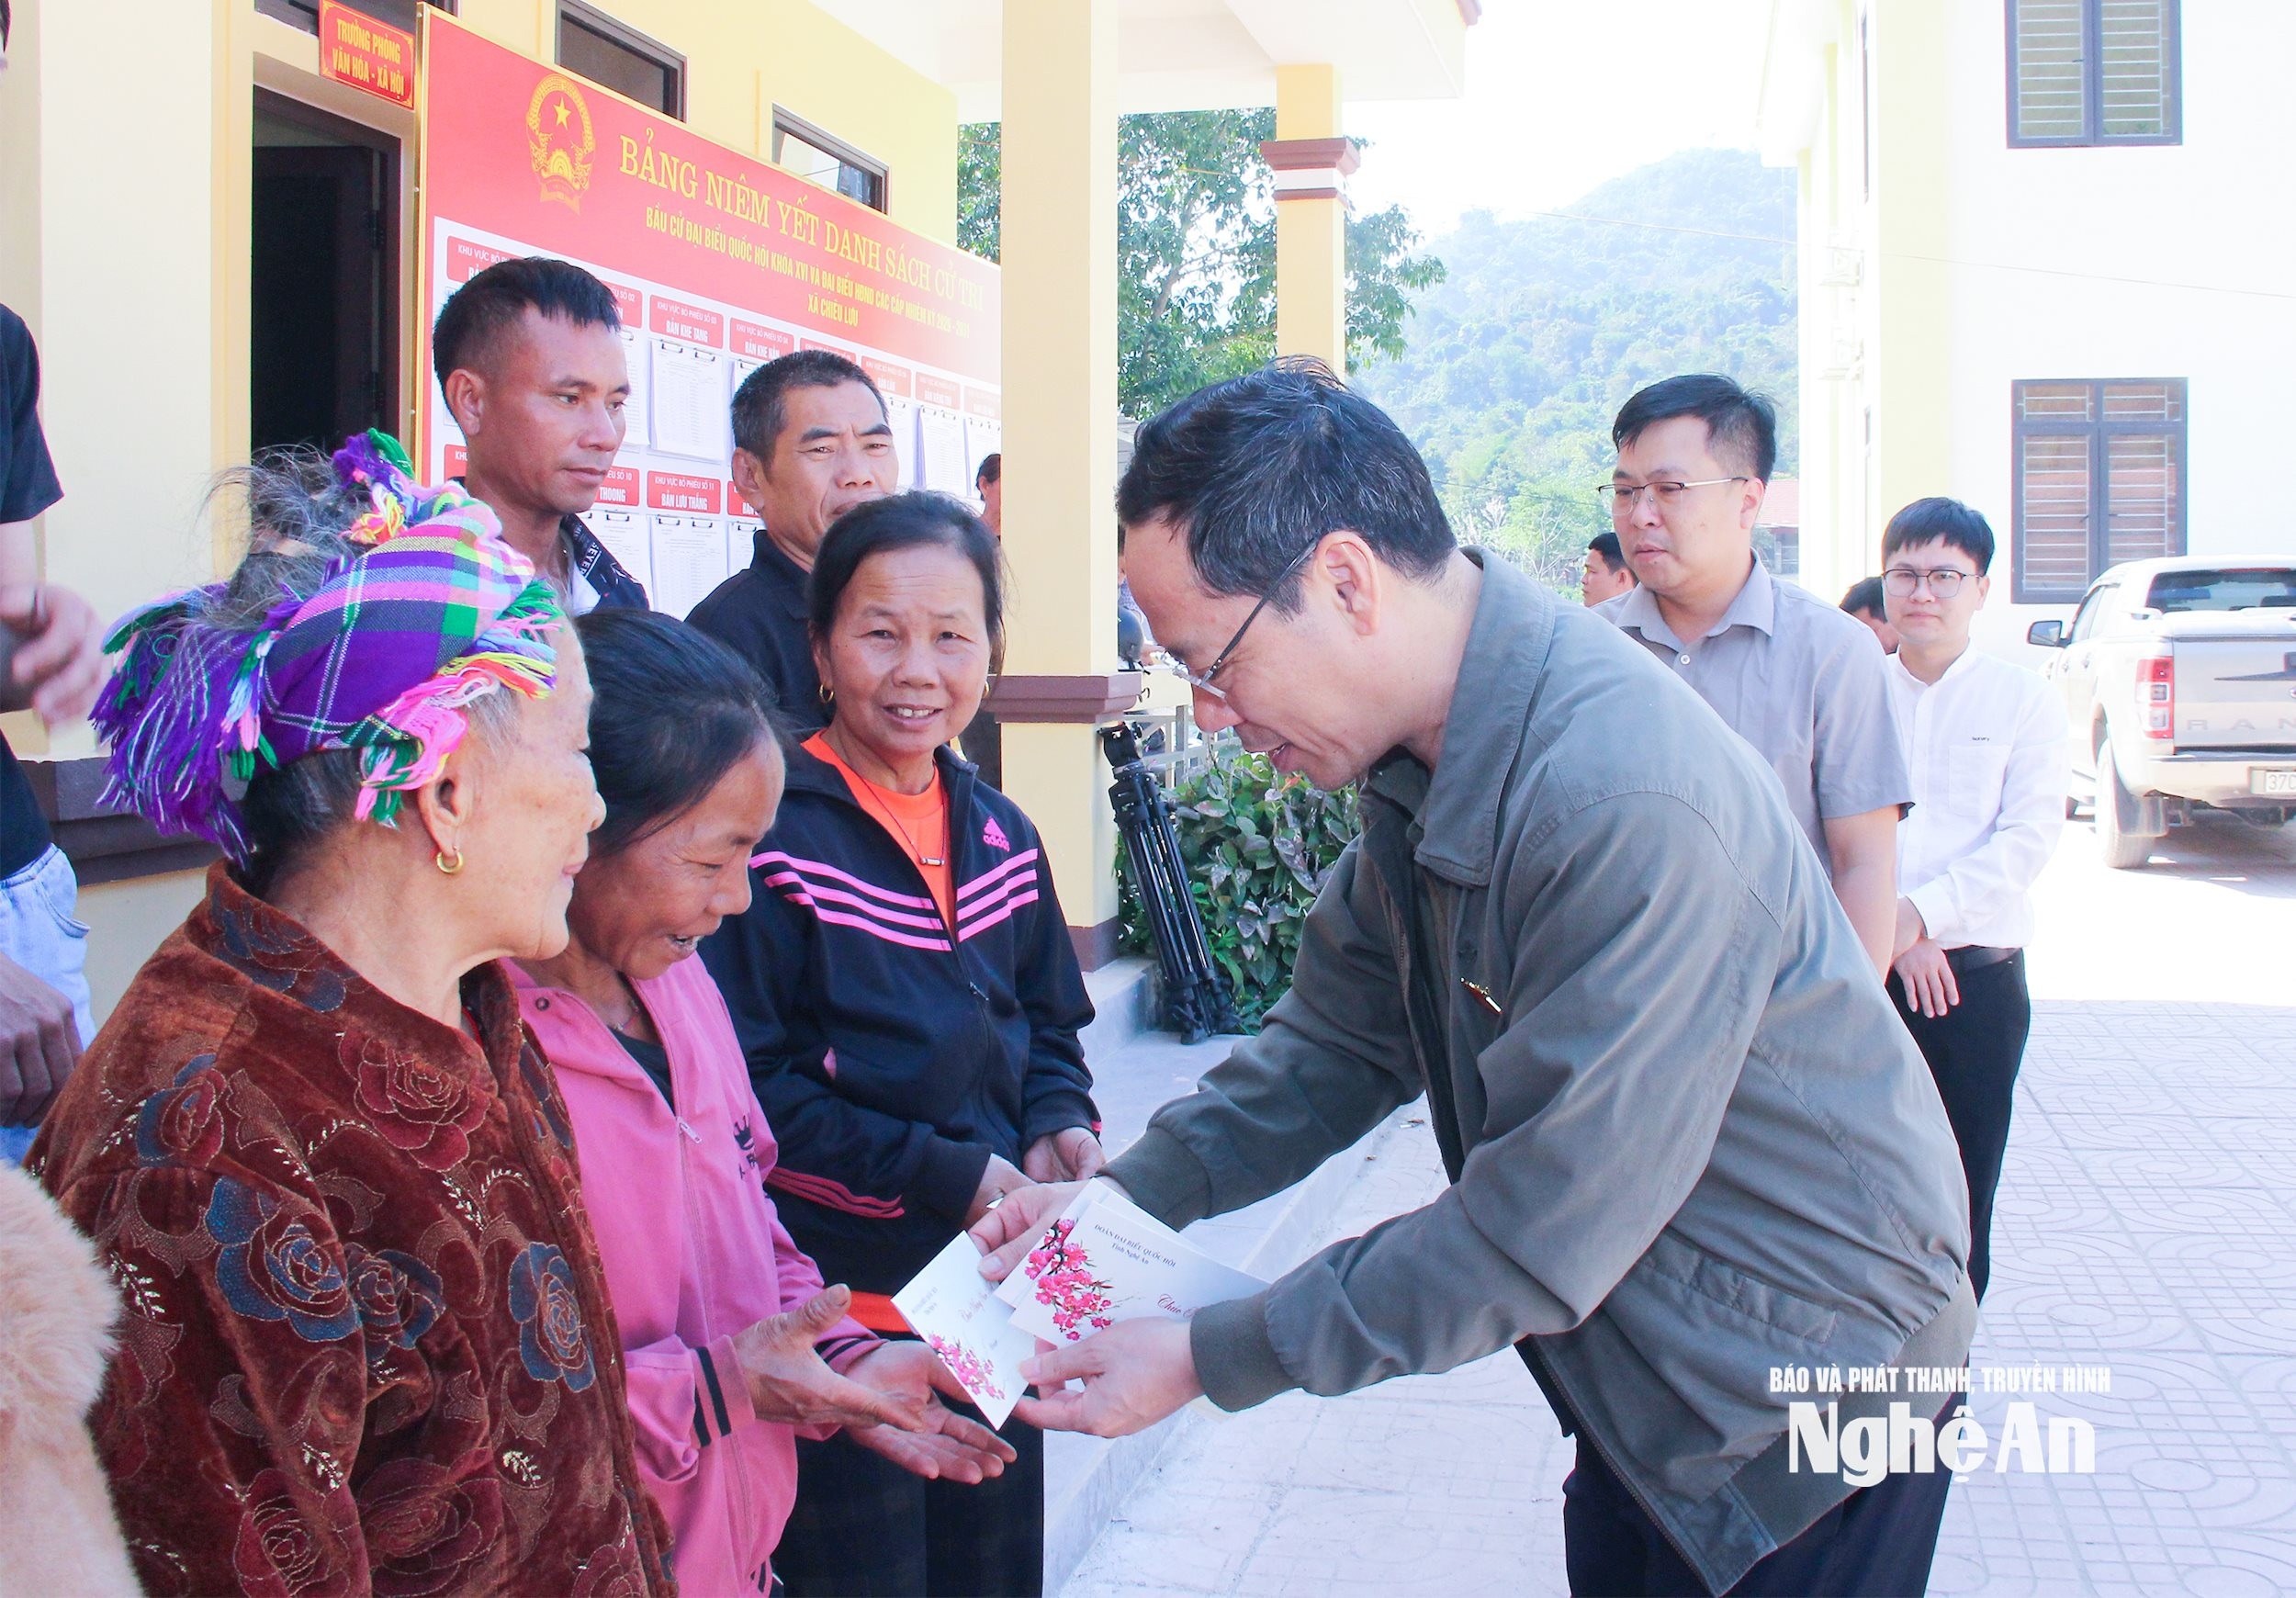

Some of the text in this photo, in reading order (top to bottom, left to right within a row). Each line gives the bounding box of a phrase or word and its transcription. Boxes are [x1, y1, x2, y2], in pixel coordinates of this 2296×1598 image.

[336, 18, 401, 65] TRƯỞNG PHÒNG
[332, 45, 351, 77] VĂN
[352, 54, 370, 84] HÓA
[377, 64, 389, 91] XÃ
[390, 69, 405, 100] HỘI
[619, 127, 985, 311] BẢNG NIÊM YẾT DANH SÁCH CỬ TRI
[457, 243, 473, 257] KHU
[474, 249, 490, 263] VỰC
[647, 202, 668, 233] BẦU
[670, 210, 685, 239] CỬ
[686, 219, 703, 248] ĐẠI
[704, 223, 726, 253] BIỂU
[728, 235, 752, 263] QUỐC
[754, 243, 770, 272] HỘI
[771, 252, 793, 277] KHÓA
[795, 260, 808, 283] XVI
[810, 264, 820, 287] VÀ
[657, 300, 669, 311] KHU
[808, 292, 819, 315] XÃ
[666, 317, 680, 336] BẢN
[655, 476, 667, 485] KHU
[666, 478, 678, 488] VỰC
[600, 486, 626, 503] THOONG
[661, 490, 675, 507] BẢN
[984, 835, 1010, 852] adidas
[1094, 1223, 1113, 1237] ĐOÀN
